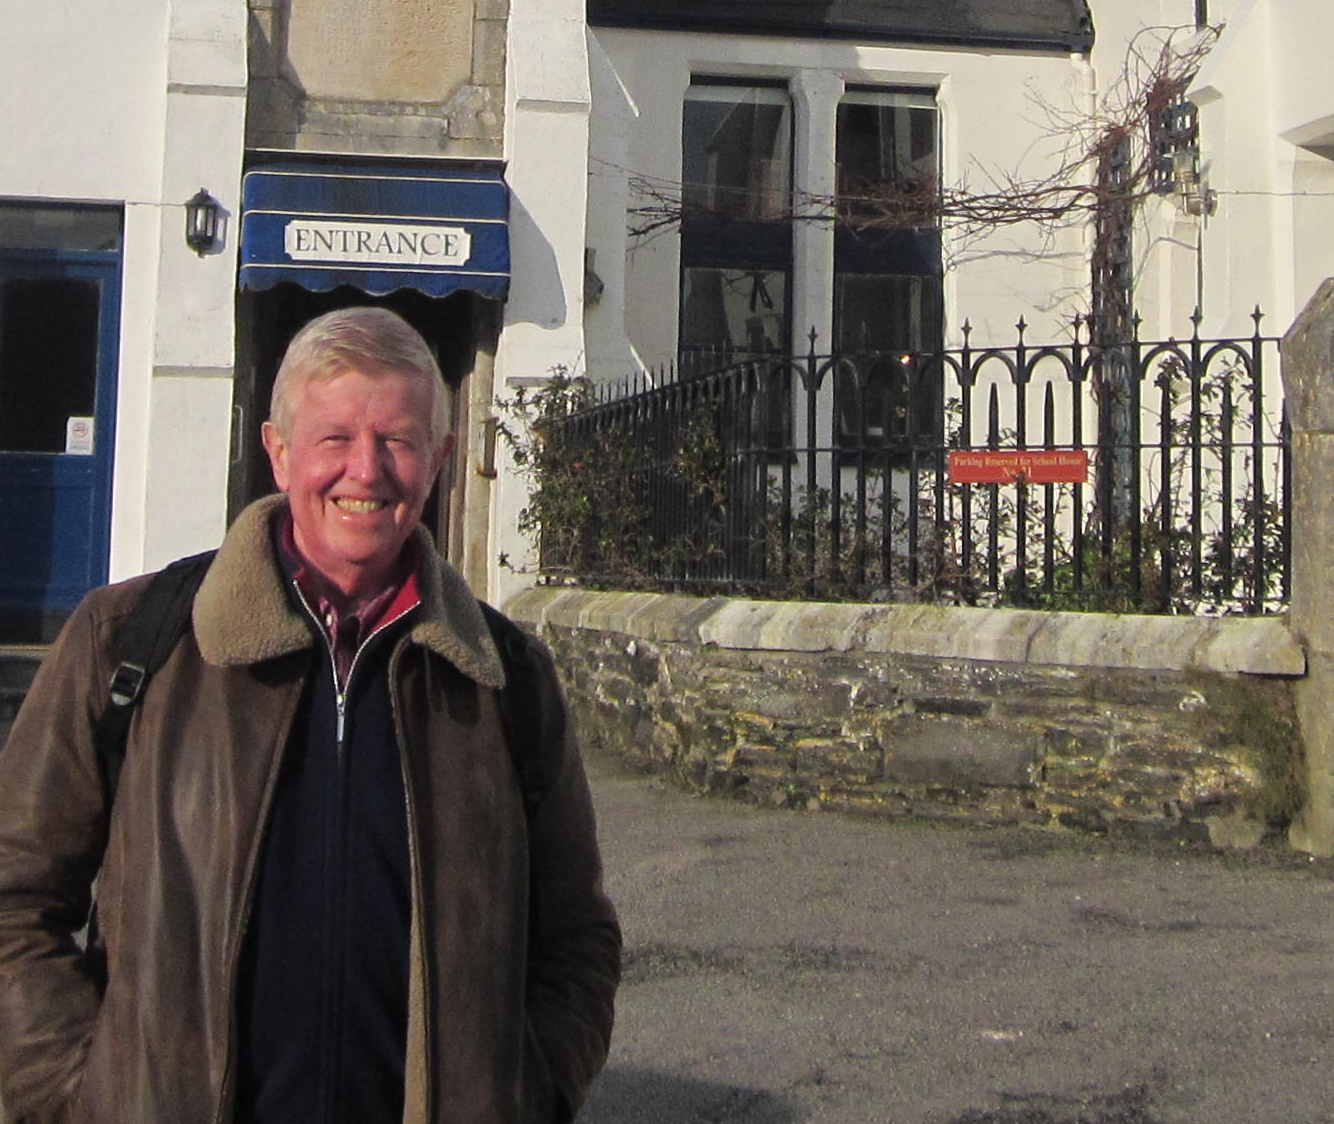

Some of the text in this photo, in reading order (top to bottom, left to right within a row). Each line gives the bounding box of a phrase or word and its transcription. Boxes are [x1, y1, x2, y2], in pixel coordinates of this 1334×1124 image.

[295, 228, 459, 257] ENTRANCE
[954, 456, 983, 468] Parking
[1020, 456, 1030, 466] for
[1033, 456, 1057, 466] School
[1059, 456, 1082, 466] House
